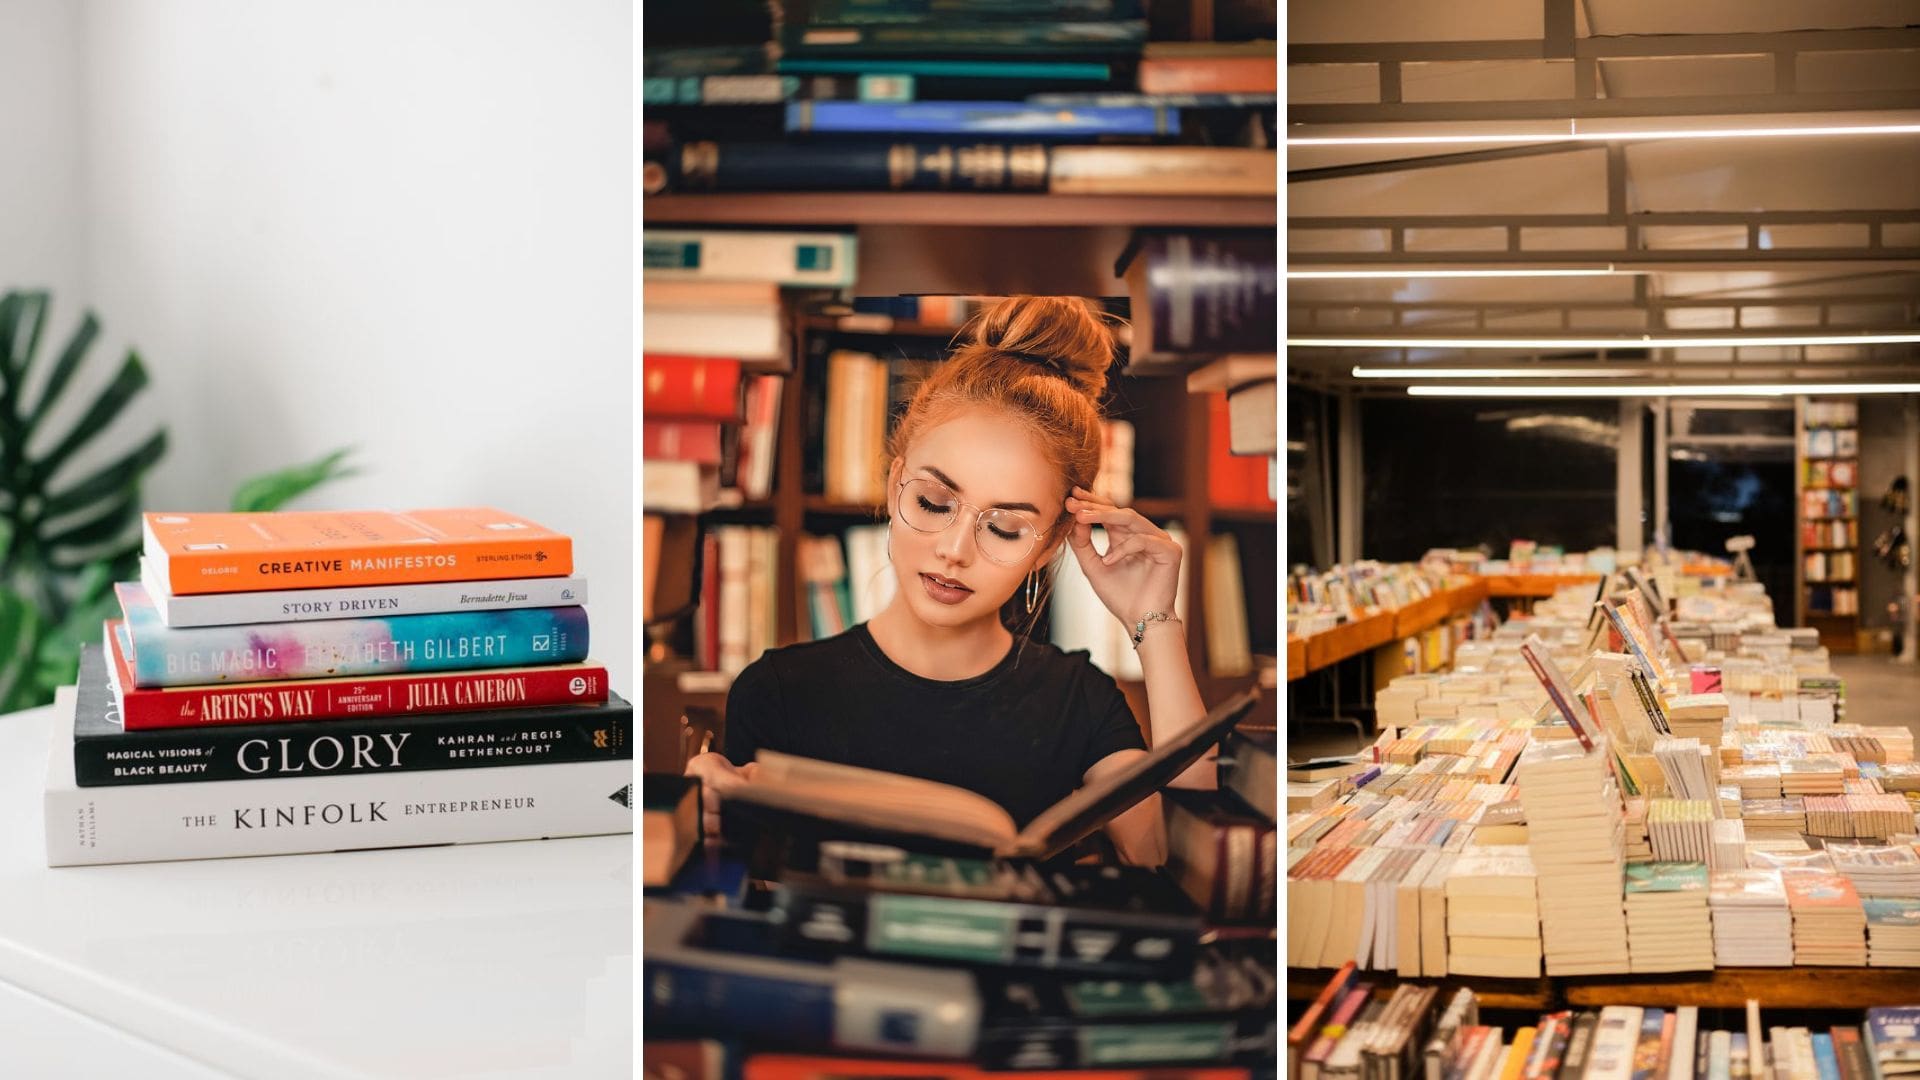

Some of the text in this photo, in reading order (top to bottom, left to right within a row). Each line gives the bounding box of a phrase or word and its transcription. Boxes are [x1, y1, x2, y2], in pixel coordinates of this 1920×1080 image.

[259, 555, 457, 575] CREATIVE MANIFESTOS
[282, 598, 399, 614] STORY DRIVEN
[460, 593, 506, 604] Bernadette
[424, 635, 507, 660] GILBERT
[167, 648, 277, 674] BIG MAGIC
[406, 677, 527, 710] JULIA CAMERON
[180, 689, 316, 721] the ARTIST'S WAY
[438, 734, 495, 745] KAHRAN
[521, 730, 562, 741] REGIS
[106, 751, 155, 760] MAGICAL
[159, 748, 202, 758] VISIONS
[236, 732, 412, 774] GLORY
[449, 744, 552, 758] BETHENCOURT
[114, 763, 208, 777] BLACK BEAUTY
[182, 797, 536, 830] THE KINFOLK ENTREPRENEUR
